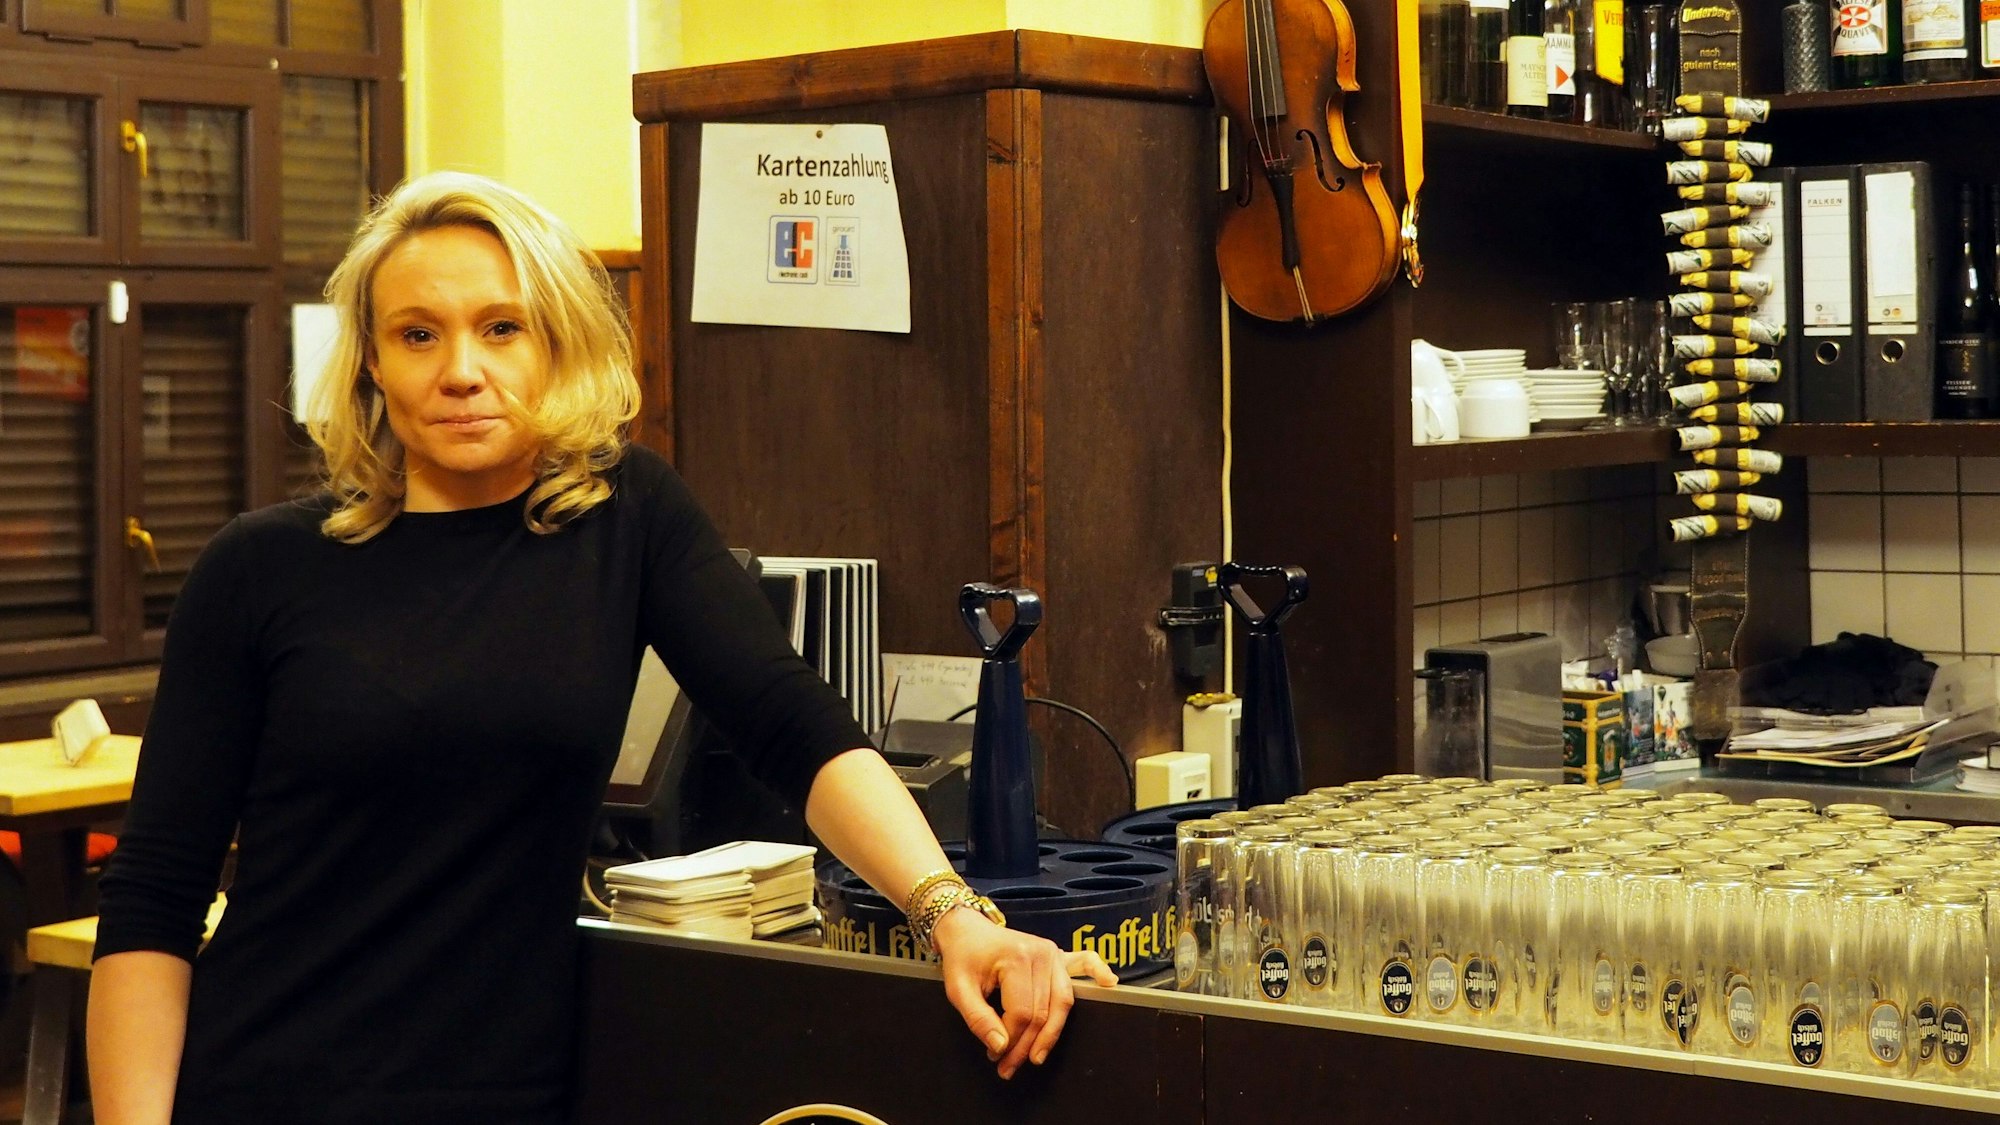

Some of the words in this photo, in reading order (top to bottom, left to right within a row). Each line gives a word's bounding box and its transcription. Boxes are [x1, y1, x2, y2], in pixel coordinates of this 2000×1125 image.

[1682, 6, 1731, 22] Underberg
[1700, 48, 1720, 57] nach
[1683, 61, 1711, 72] gutem
[1713, 59, 1737, 70] Essen
[757, 153, 889, 184] Kartenzahlung
[779, 189, 798, 205] ab
[804, 190, 821, 205] 10
[826, 190, 855, 206] Euro
[1072, 911, 1161, 968] Gaffel
[1261, 968, 1289, 982] Gaffel
[1383, 983, 1412, 996] Gaffel
[1791, 1032, 1822, 1046] Gaffel
